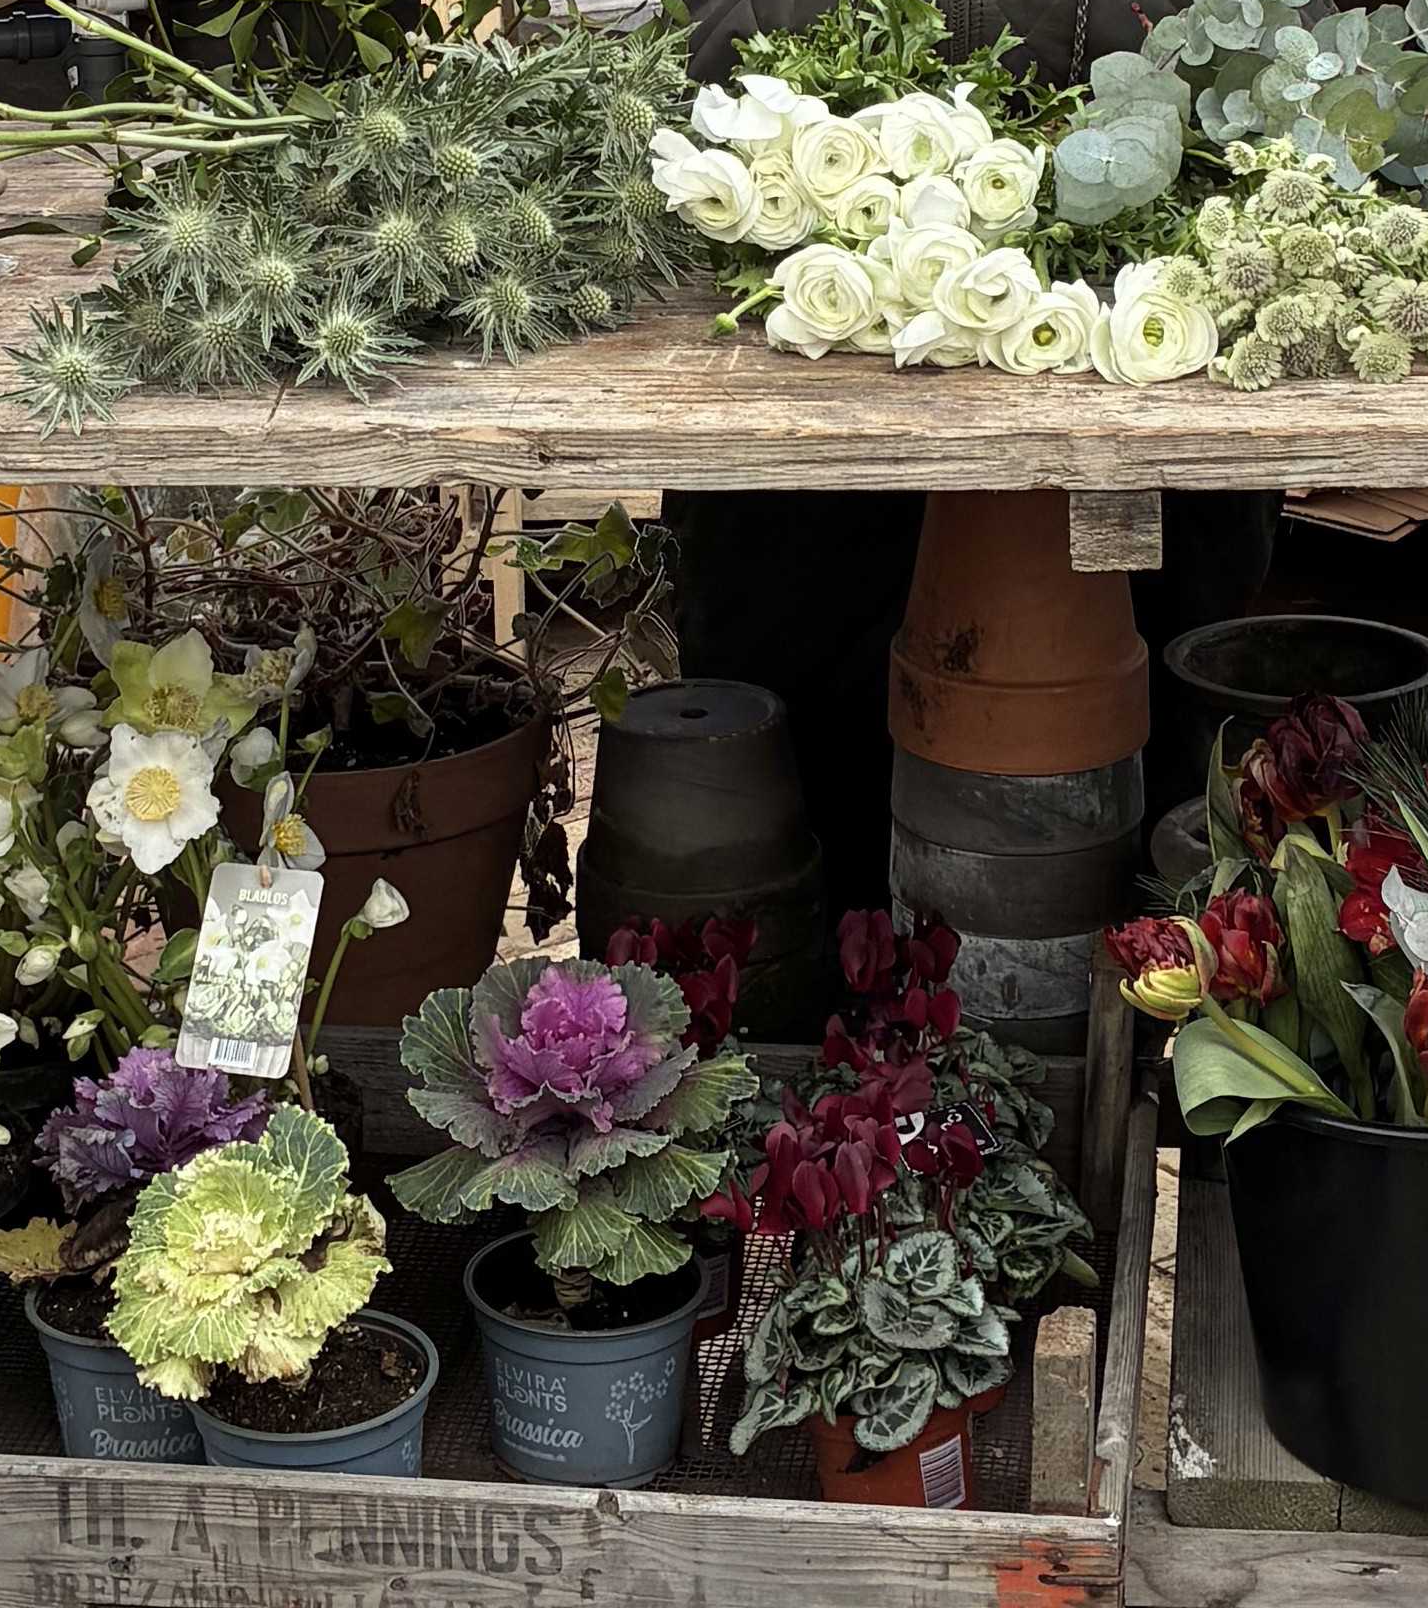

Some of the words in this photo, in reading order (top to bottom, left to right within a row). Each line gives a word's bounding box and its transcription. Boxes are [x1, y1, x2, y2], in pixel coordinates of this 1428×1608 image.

[494, 1357, 566, 1394] ELVIRA
[492, 1397, 584, 1449] Brassica
[89, 1427, 199, 1459] Brassica
